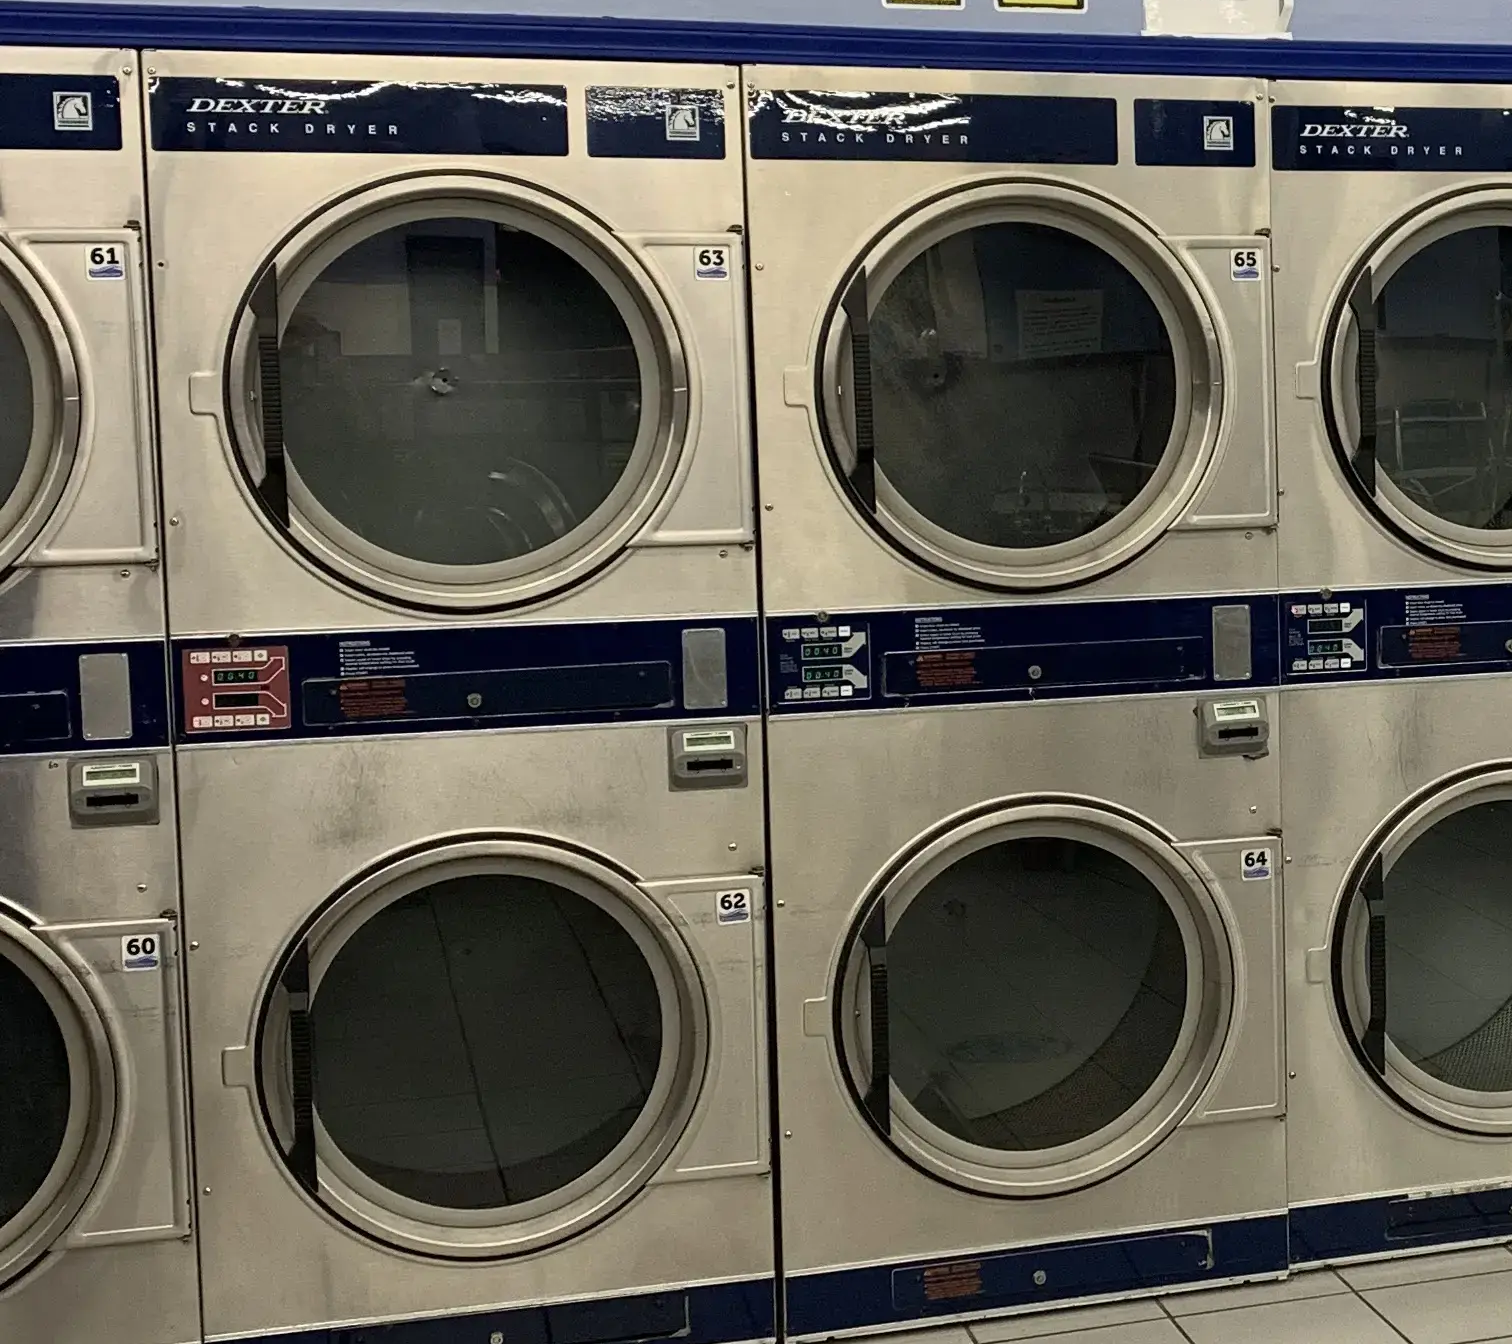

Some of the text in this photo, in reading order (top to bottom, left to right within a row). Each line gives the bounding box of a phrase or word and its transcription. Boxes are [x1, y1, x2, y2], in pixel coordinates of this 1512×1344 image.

[186, 98, 325, 114] DEXTER
[186, 121, 398, 136] STACK DRYER
[1299, 123, 1407, 138] DEXTER
[781, 131, 969, 144] STACK DRYER
[1299, 145, 1463, 155] STACK DRYER
[90, 247, 120, 265] 61
[699, 250, 725, 266] 63
[1234, 252, 1257, 267] 65
[1244, 851, 1268, 867] 64
[720, 892, 746, 910] 62
[126, 937, 156, 955] 60
